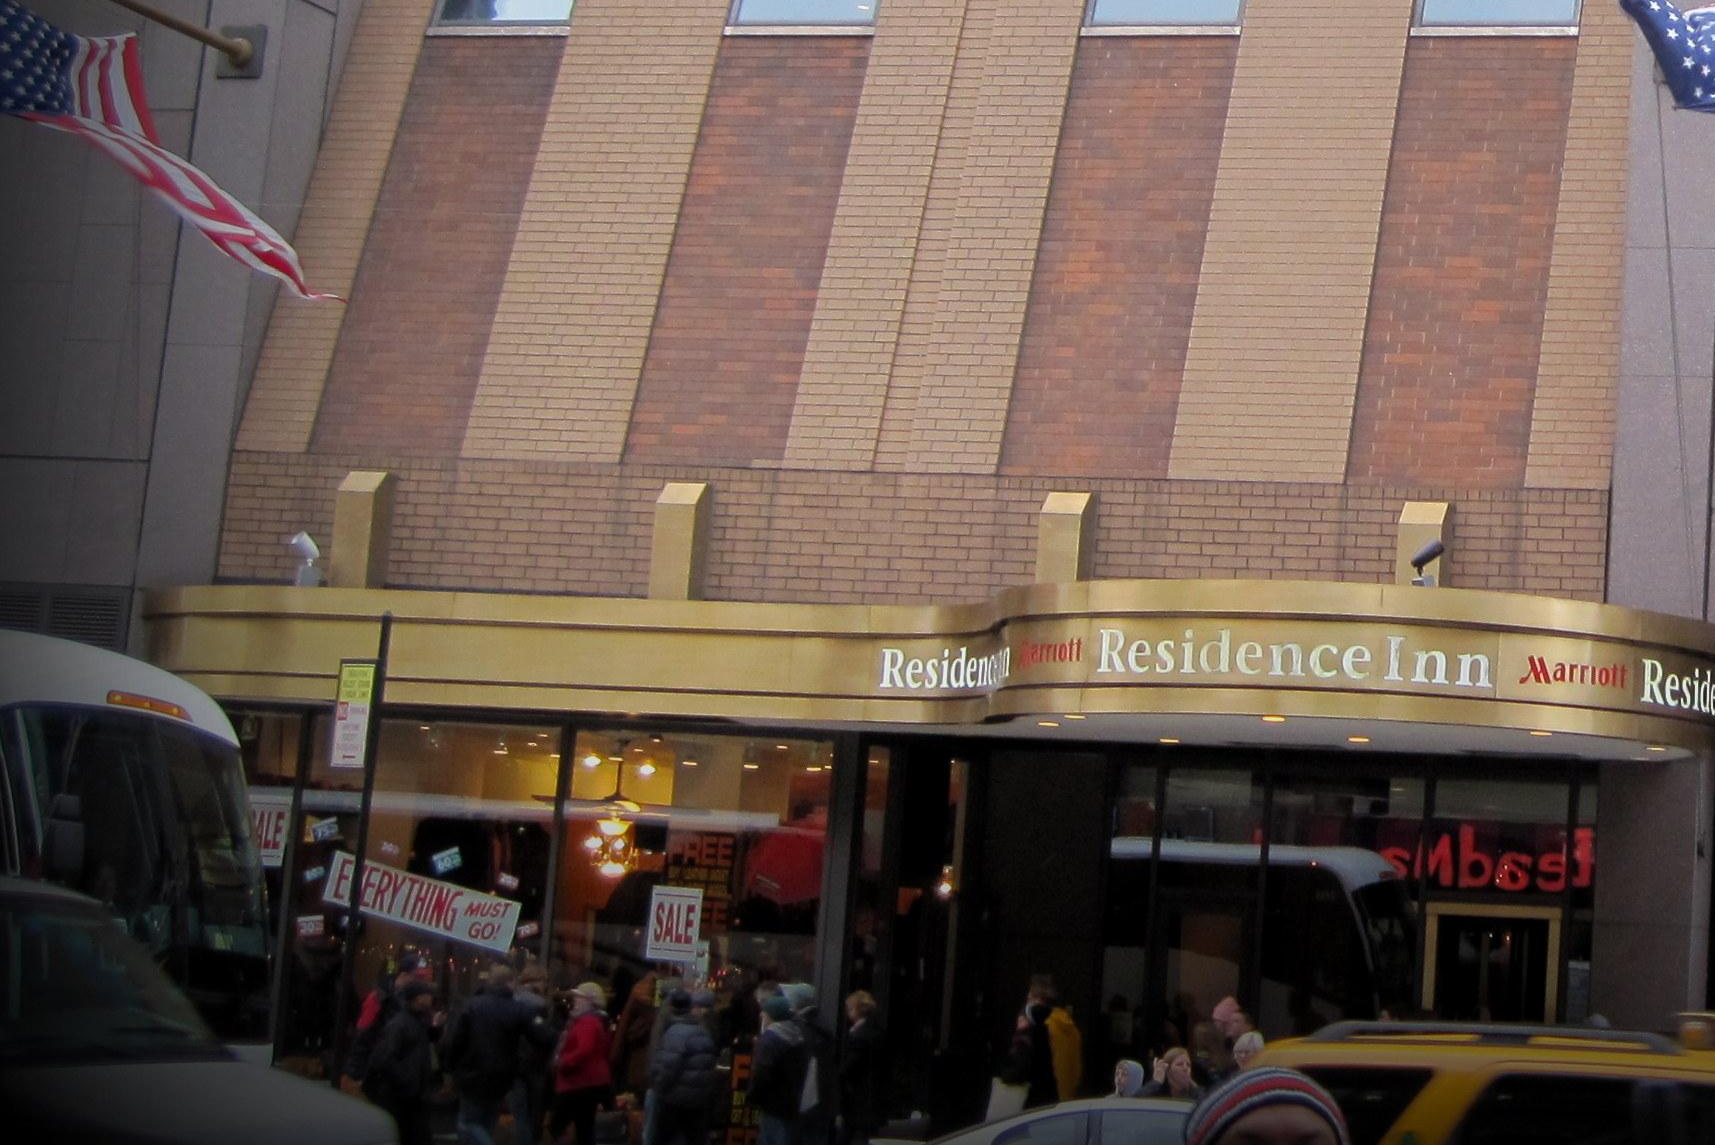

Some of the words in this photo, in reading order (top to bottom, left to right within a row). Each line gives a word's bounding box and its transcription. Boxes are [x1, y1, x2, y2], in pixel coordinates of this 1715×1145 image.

[879, 646, 999, 689] Residenc
[1020, 637, 1083, 671] Marriott
[1097, 627, 1371, 680] Residence
[1384, 635, 1493, 688] Inn
[1519, 654, 1628, 689] Marriott
[464, 900, 513, 919] MUST
[653, 901, 698, 945] SALE
[467, 921, 502, 941] GO!
